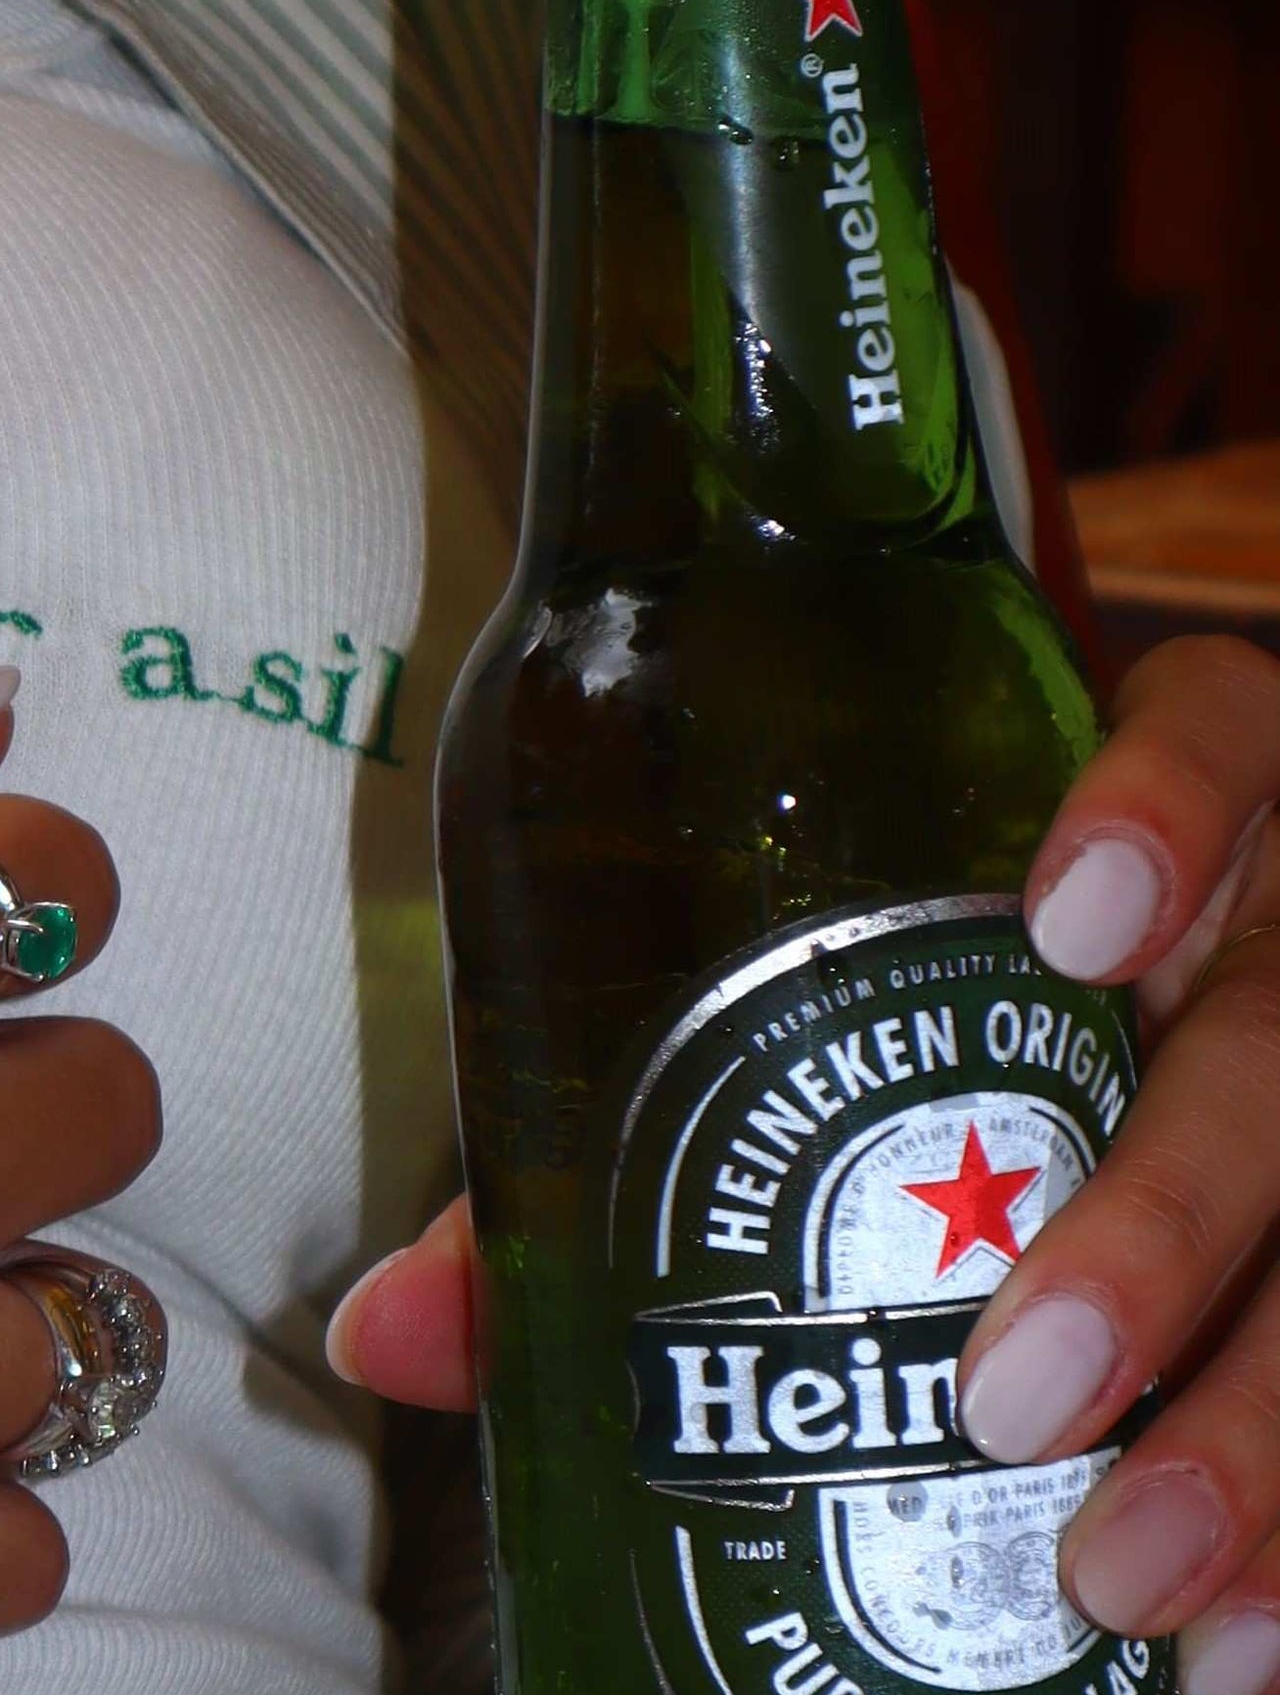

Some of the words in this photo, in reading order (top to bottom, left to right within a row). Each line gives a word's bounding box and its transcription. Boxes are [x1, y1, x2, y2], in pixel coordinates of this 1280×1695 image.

[822, 62, 905, 432] Heineken
[752, 977, 875, 1053] PREMIUM
[889, 954, 995, 990] QUALITY
[706, 1005, 960, 1255] HEINEKEN
[985, 999, 1126, 1137] ORIGIN
[666, 1338, 961, 1454] Hein
[724, 1540, 788, 1562] TRADE
